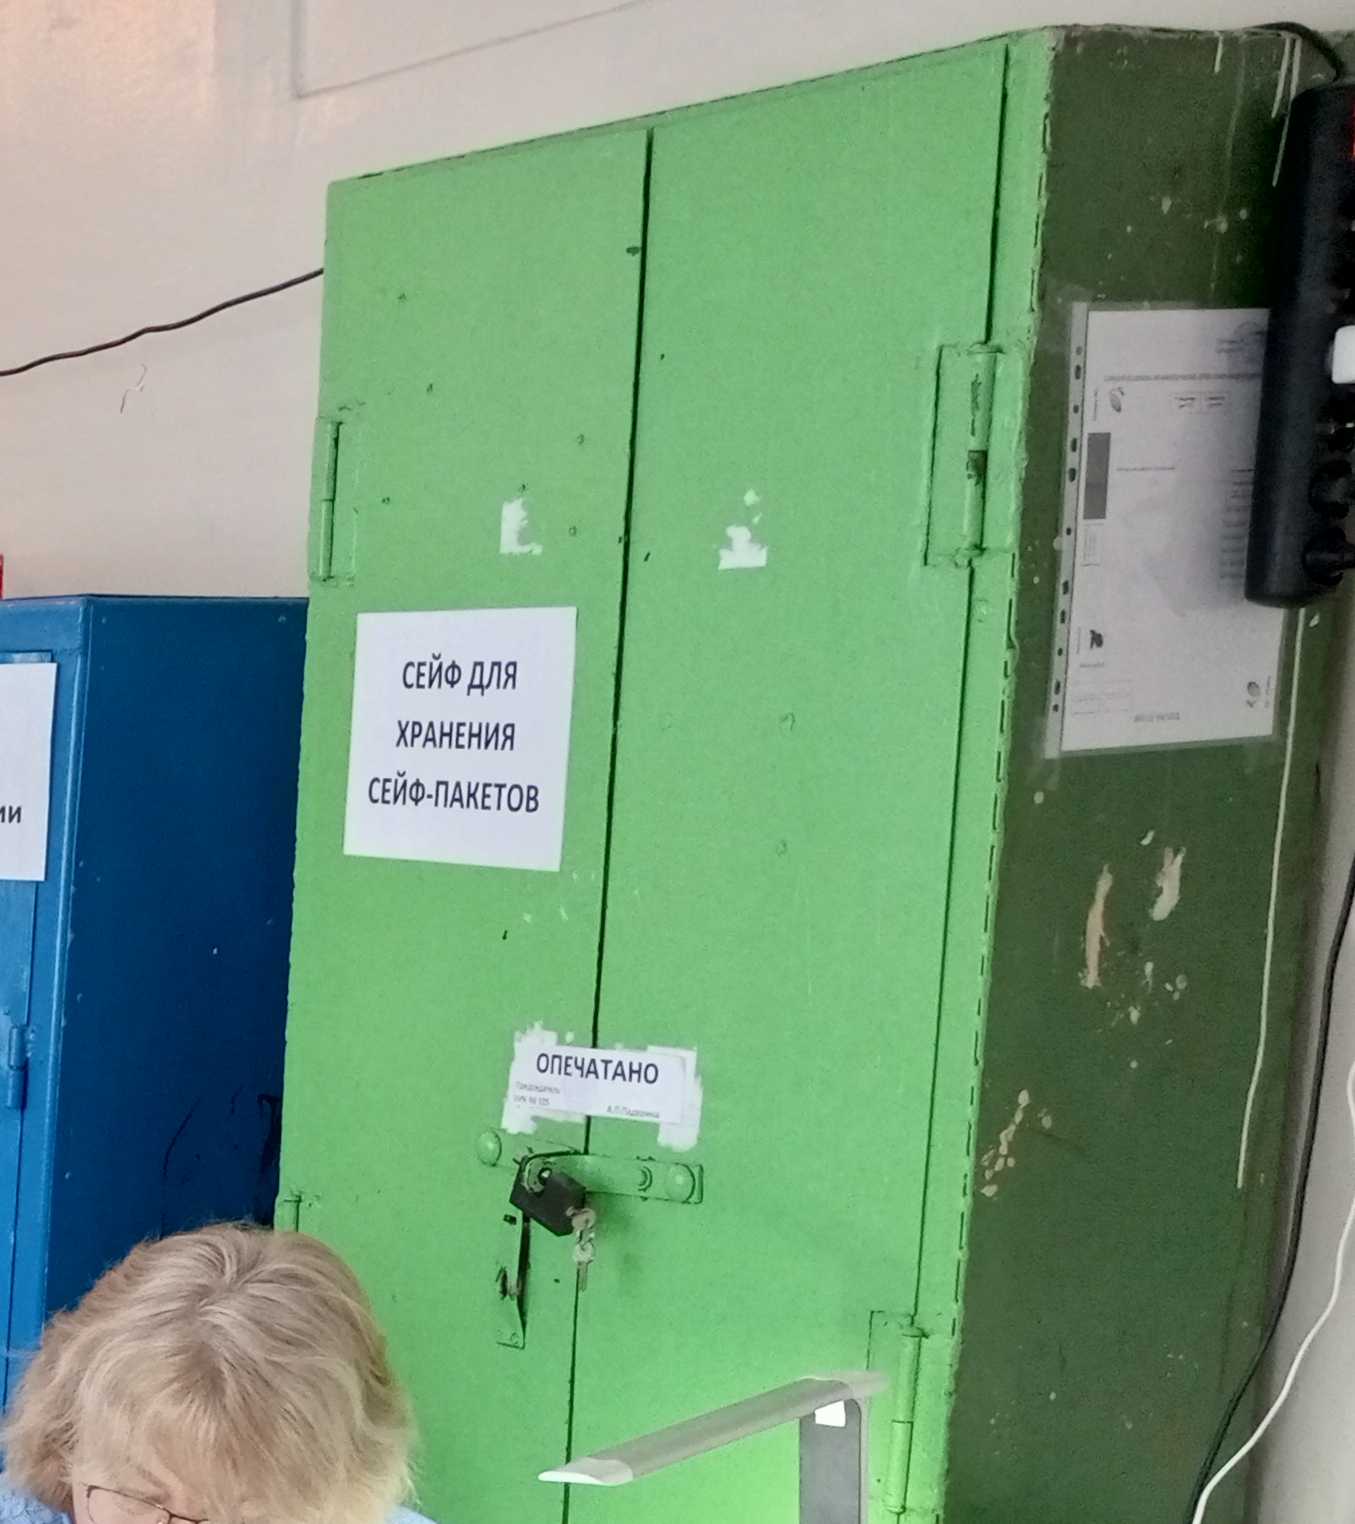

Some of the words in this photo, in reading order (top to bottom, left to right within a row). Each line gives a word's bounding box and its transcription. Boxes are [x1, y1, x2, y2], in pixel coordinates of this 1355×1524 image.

[402, 653, 462, 690] СЕЙФ
[466, 661, 518, 697] ДЛЯ
[396, 719, 516, 752] ХРАНЕНИЯ
[368, 770, 540, 813] СЕЙФ-ПАКЕТОВ
[536, 1052, 660, 1085] ОПЕЧАТАНО
